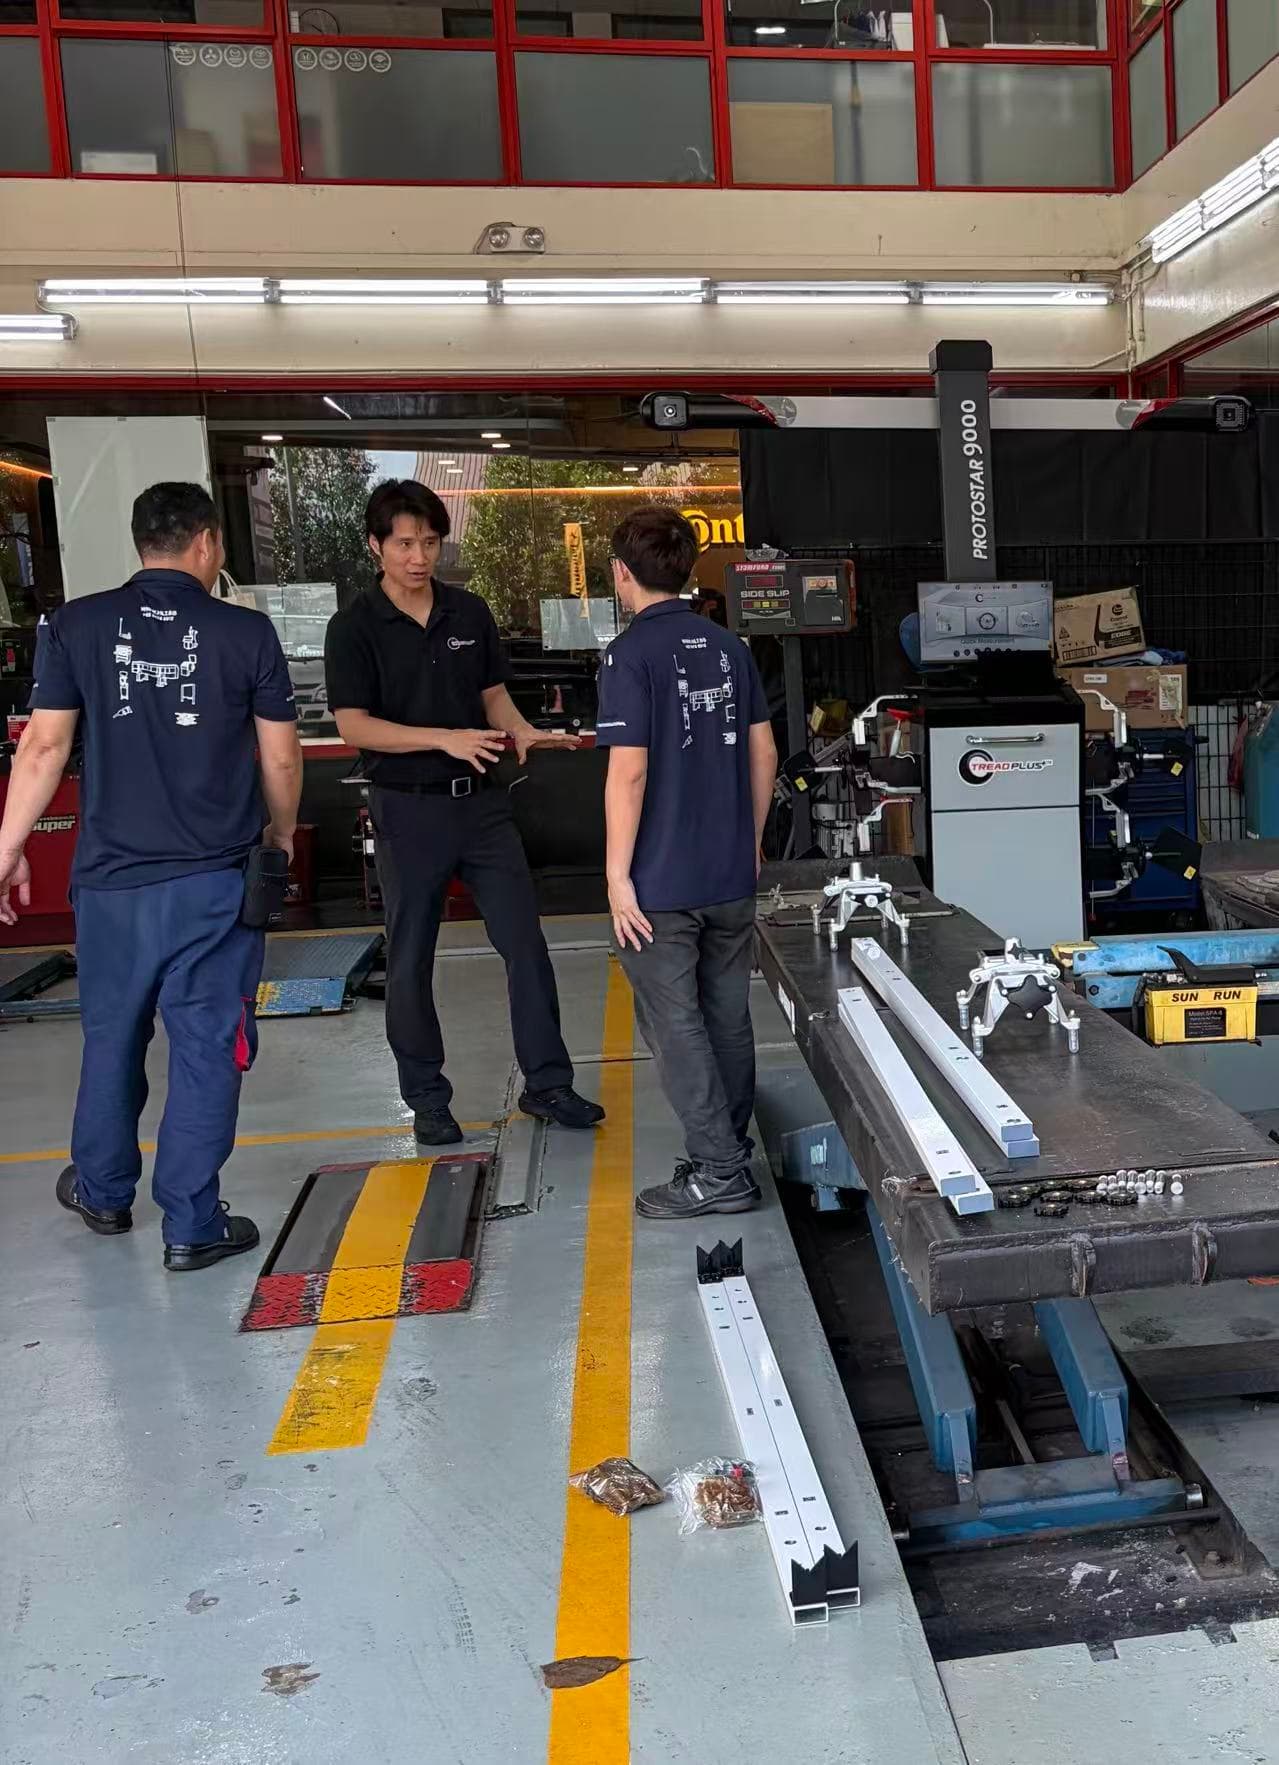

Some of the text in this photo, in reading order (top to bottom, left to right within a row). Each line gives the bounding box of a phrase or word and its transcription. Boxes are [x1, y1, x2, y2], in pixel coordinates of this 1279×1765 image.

[960, 400, 988, 560] PROTOSTAR 9000
[740, 589, 790, 598] SIDE SLIP
[1172, 990, 1242, 1003] SUN RUN
